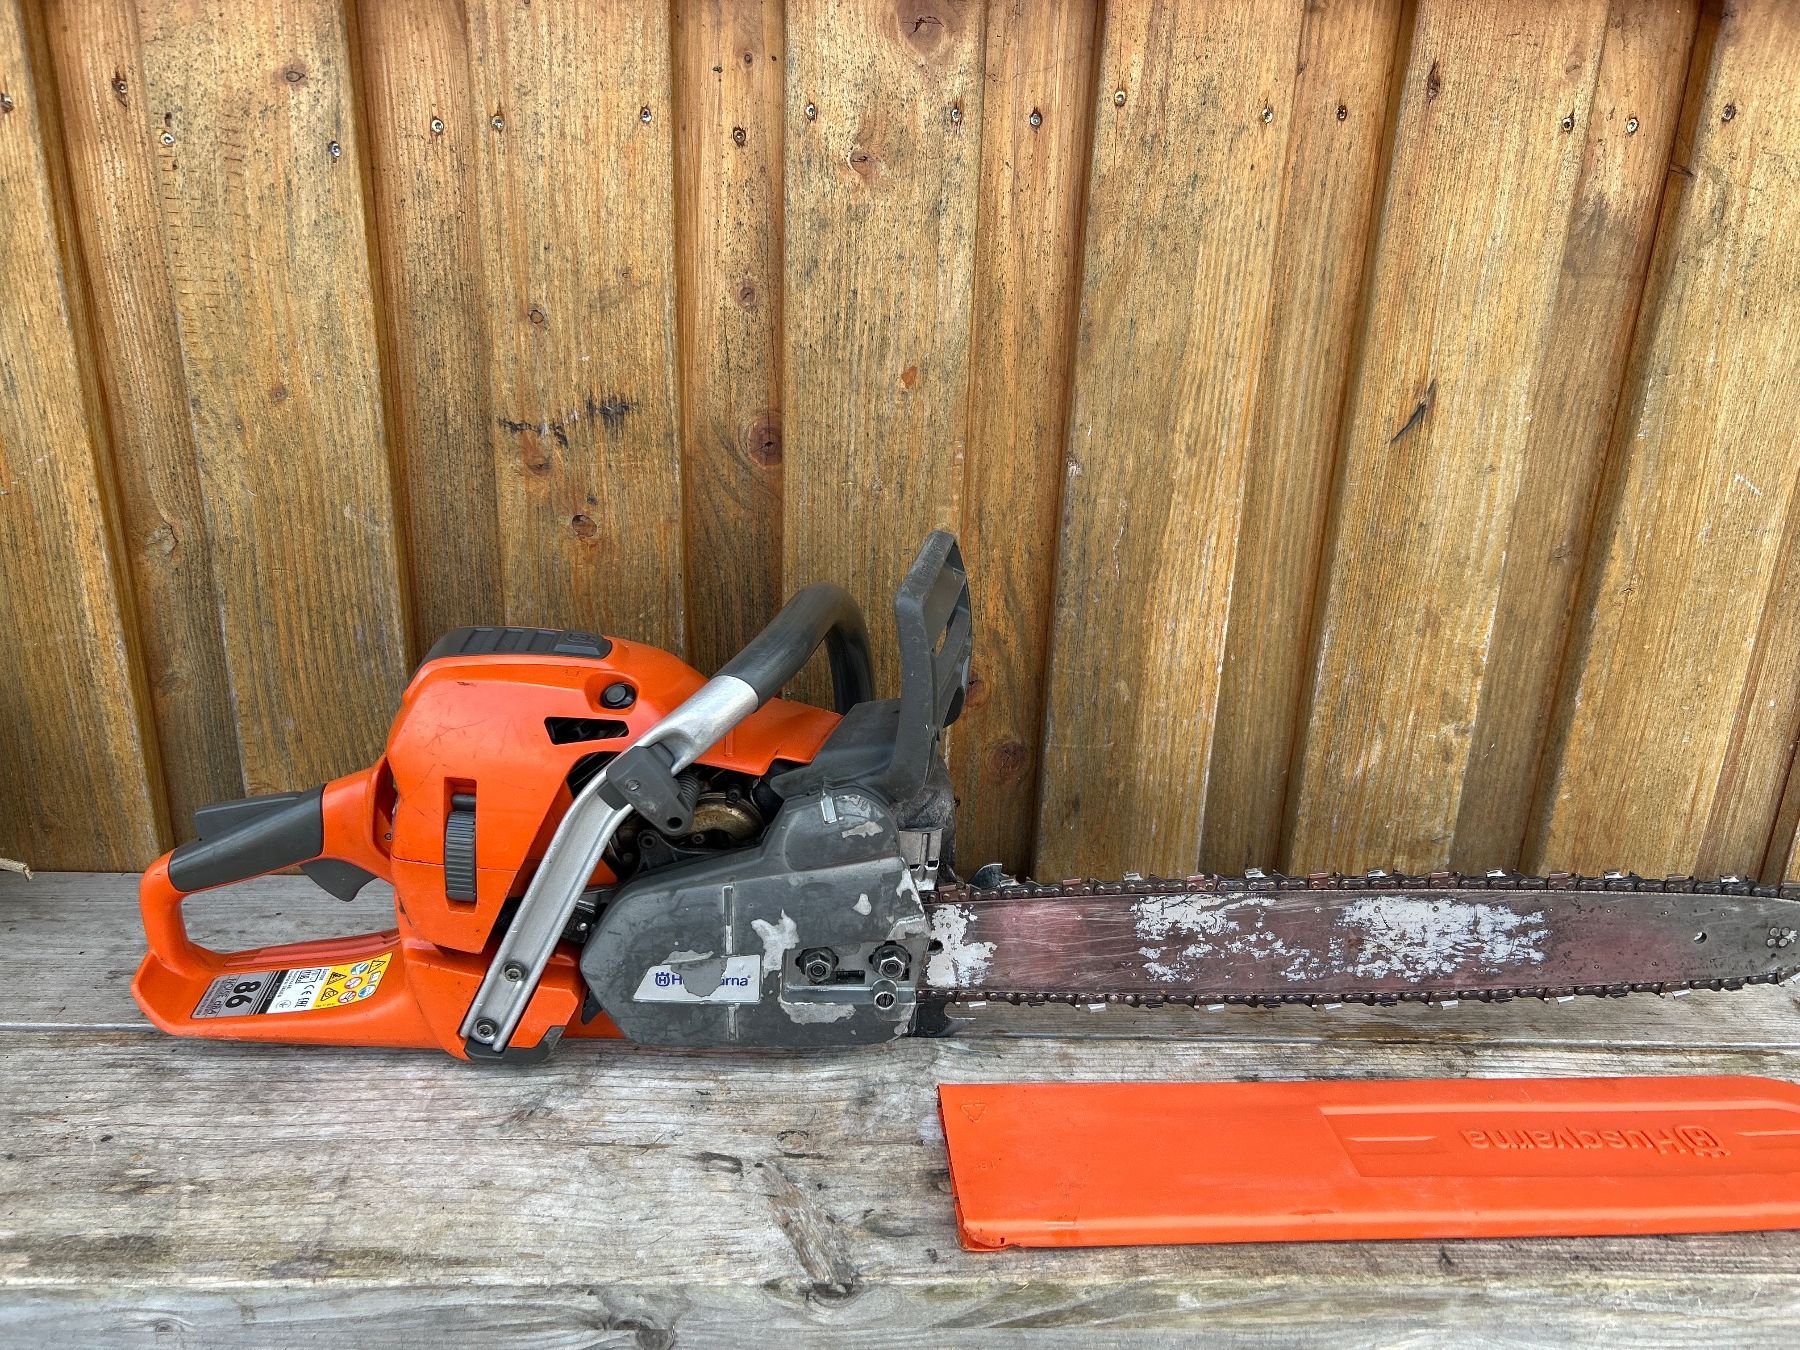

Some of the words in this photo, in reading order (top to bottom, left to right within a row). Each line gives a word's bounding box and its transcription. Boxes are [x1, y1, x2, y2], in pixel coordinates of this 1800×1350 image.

[671, 974, 748, 986] Harna
[225, 981, 262, 1008] 86
[1459, 1126, 1688, 1154] Husqvarna
